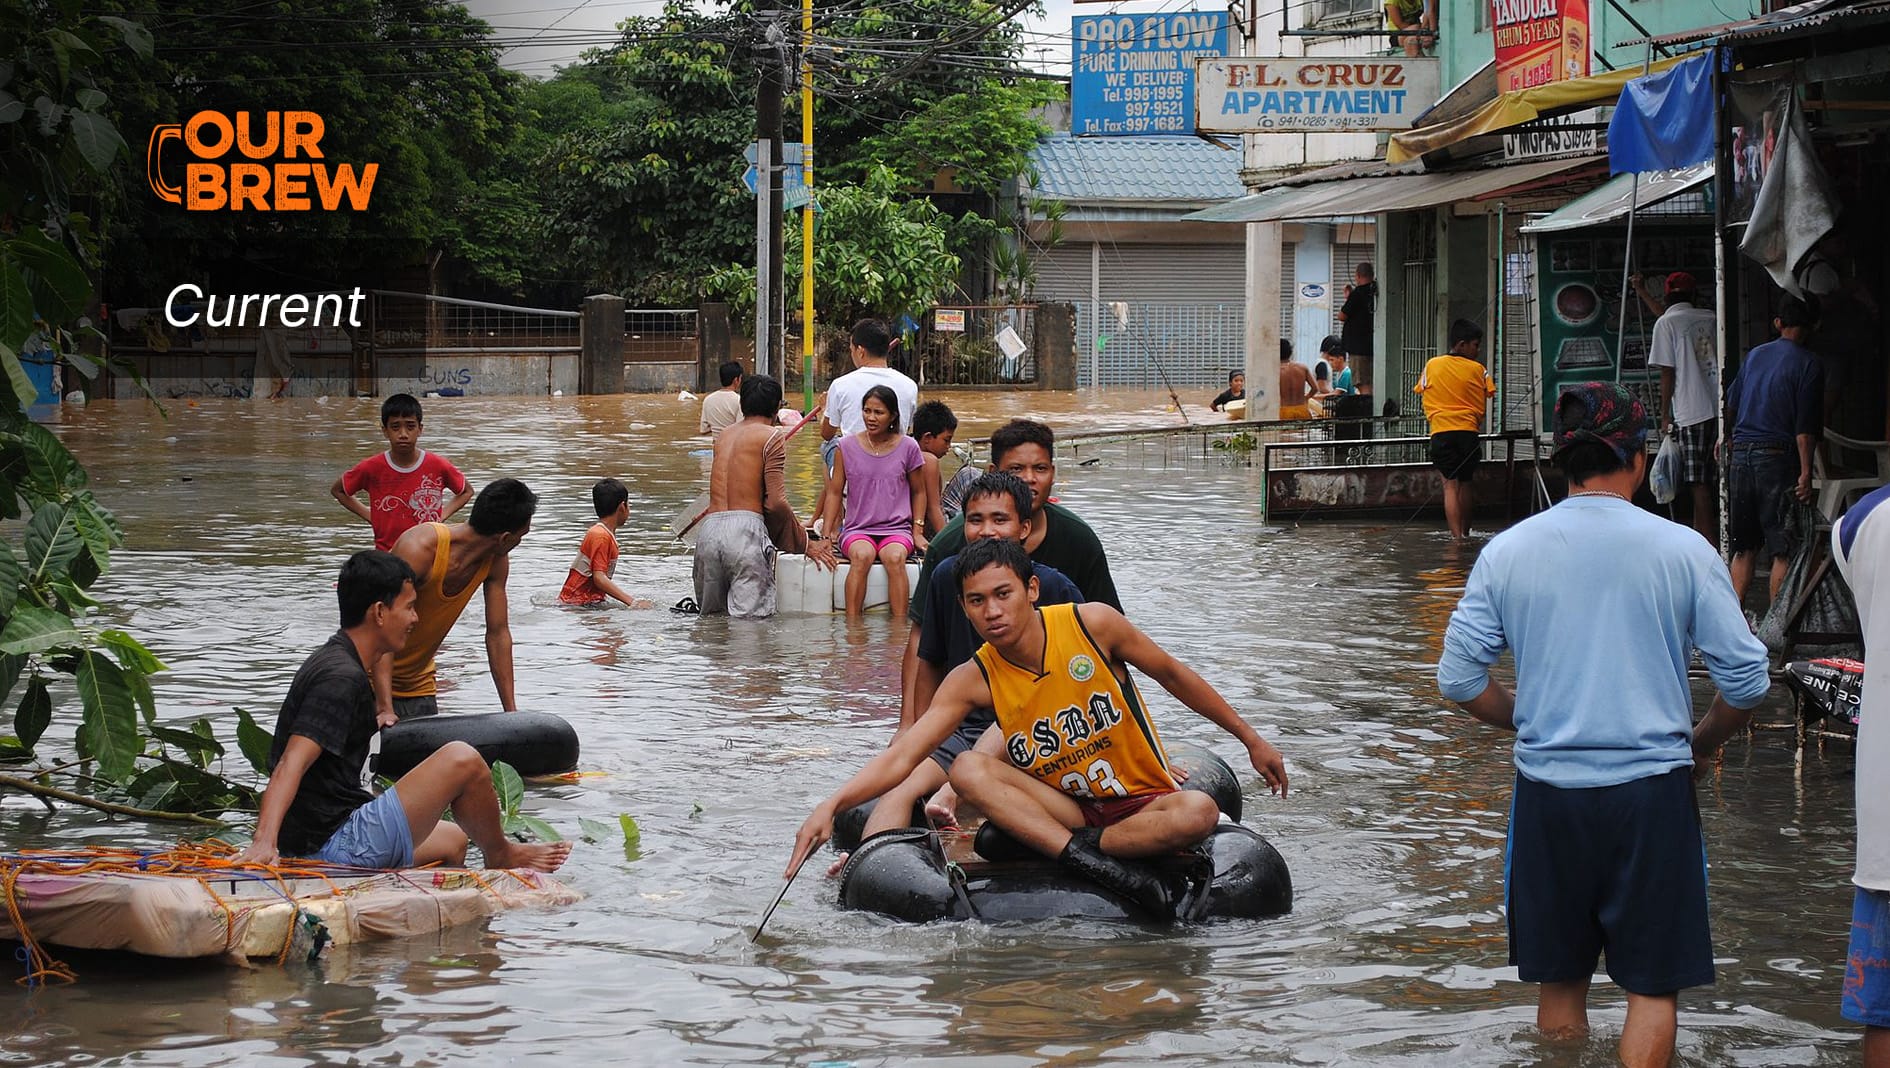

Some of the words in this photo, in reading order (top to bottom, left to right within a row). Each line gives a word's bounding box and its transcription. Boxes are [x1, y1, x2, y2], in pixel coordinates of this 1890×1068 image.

[1080, 17, 1135, 51] PRO
[1143, 15, 1219, 49] FLOW
[1497, 25, 1523, 49] RHUM
[1522, 23, 1531, 45] 5
[1530, 18, 1560, 42] YEARS
[1079, 53, 1116, 72] PURE
[1120, 50, 1178, 71] DRINKING
[1106, 73, 1127, 87] WE
[1133, 71, 1188, 86] DELIVER:
[1297, 63, 1406, 88] CRUZ
[1221, 89, 1407, 115] APARTMENT
[418, 365, 472, 385] GUNS
[1034, 735, 1112, 778] CENTURIONS
